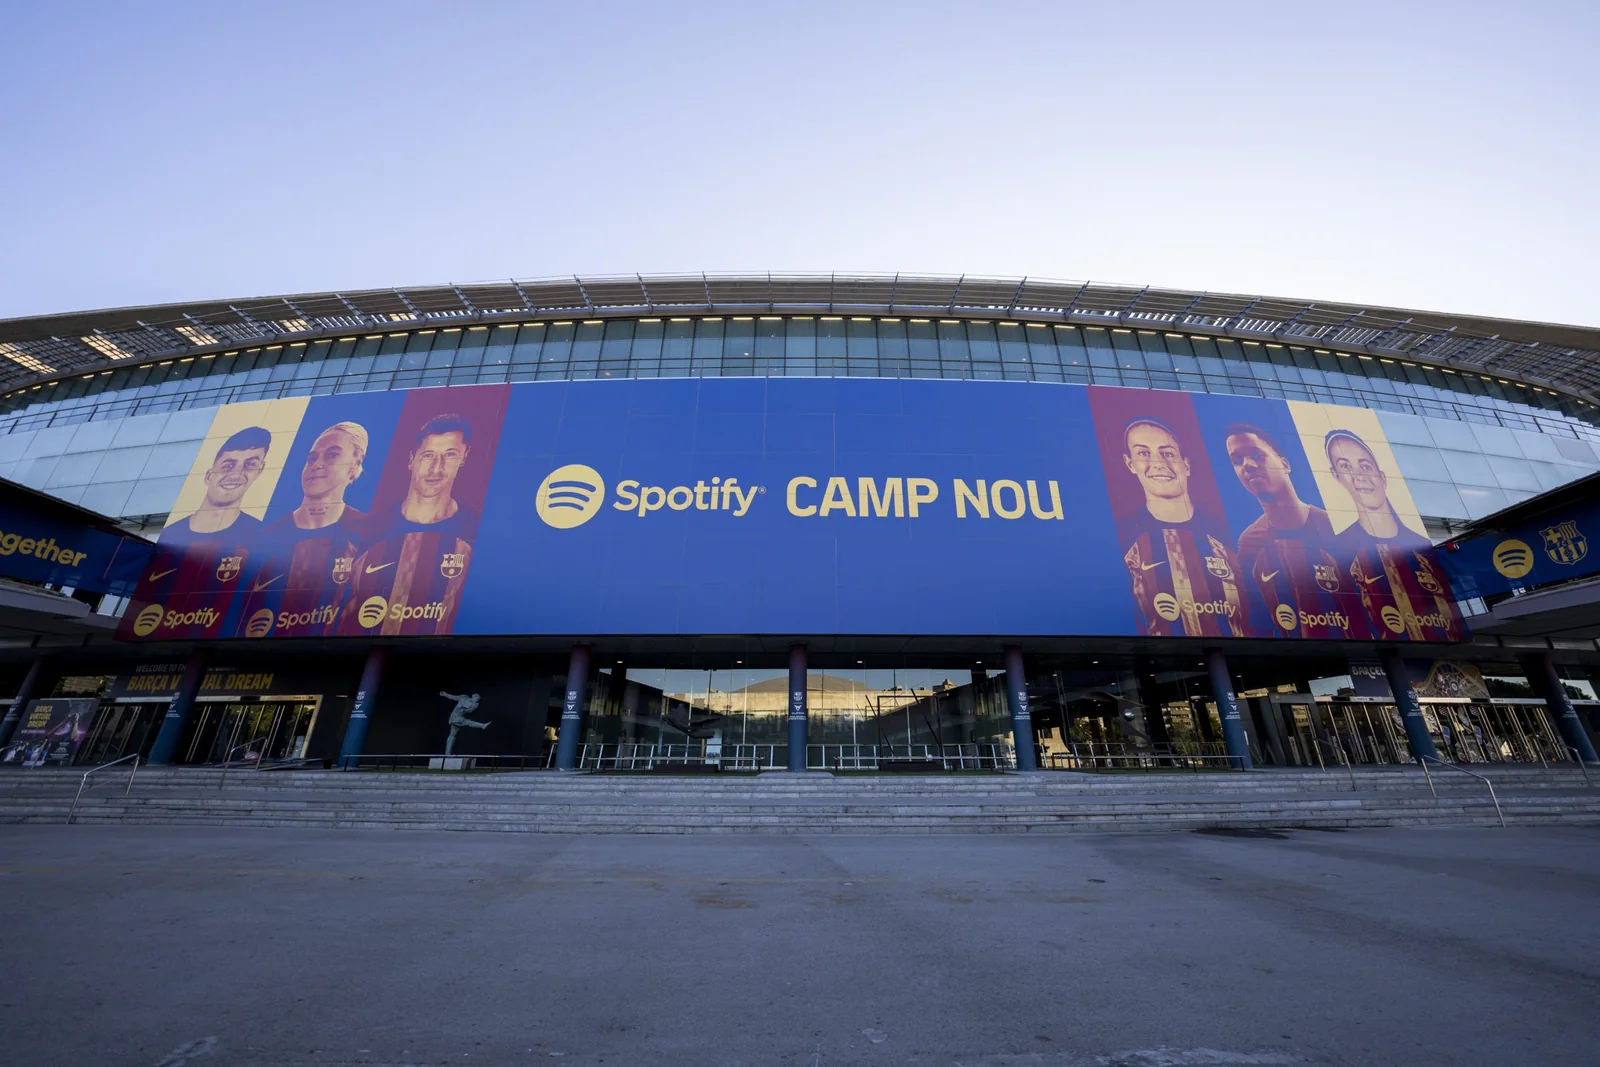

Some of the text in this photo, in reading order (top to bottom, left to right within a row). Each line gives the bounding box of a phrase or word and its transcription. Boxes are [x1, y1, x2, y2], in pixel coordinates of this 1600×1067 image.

[787, 476, 939, 517] CAMP
[953, 478, 1064, 520] NOU
[0, 529, 87, 567] gether
[164, 607, 220, 629] Spotify
[276, 604, 340, 630] Spotify
[389, 600, 447, 623] Spotify
[1182, 600, 1236, 618] Spotify
[1299, 610, 1349, 632] Spotify
[1405, 611, 1451, 631] Spotify
[135, 664, 168, 672] WELCOME
[168, 664, 177, 672] TO
[224, 673, 275, 690] DREAM
